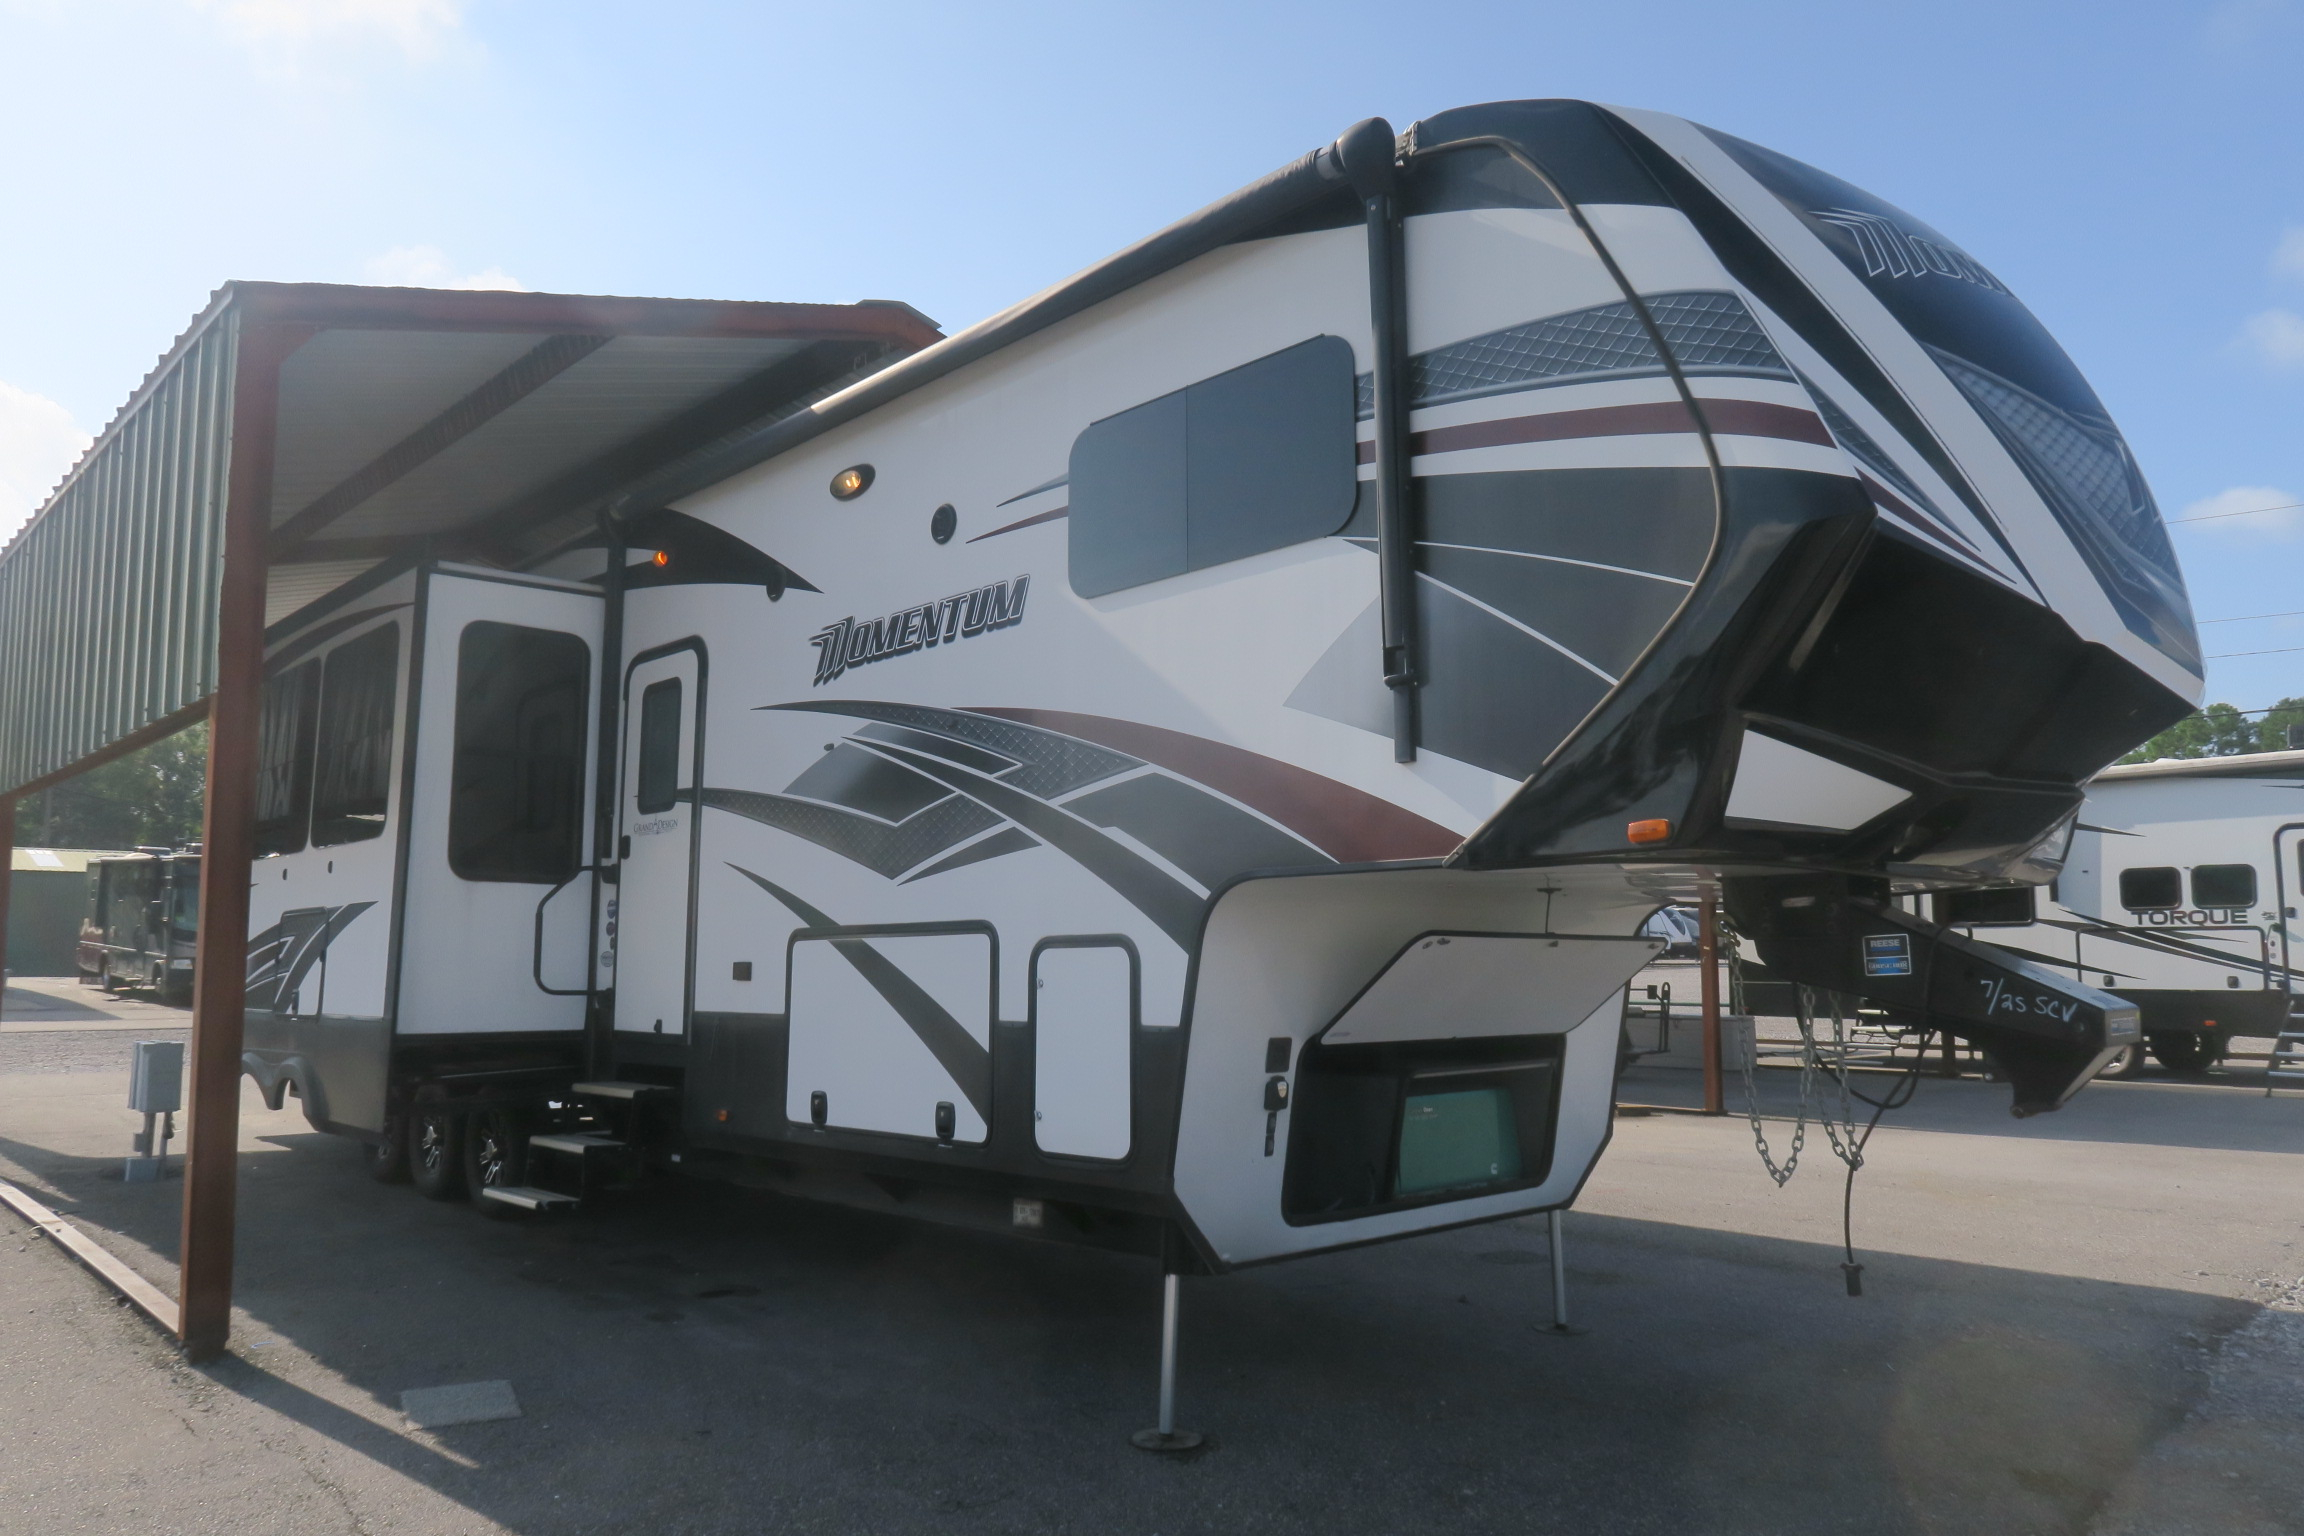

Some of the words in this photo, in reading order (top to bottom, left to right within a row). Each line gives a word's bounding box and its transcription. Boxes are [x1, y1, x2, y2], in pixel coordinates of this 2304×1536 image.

[808, 573, 1031, 687] MOMENTUM
[2131, 909, 2248, 926] TORQUE
[1870, 939, 1901, 948] REESE
[1980, 978, 2027, 1015] 7/25
[2034, 996, 2078, 1022] SCV
